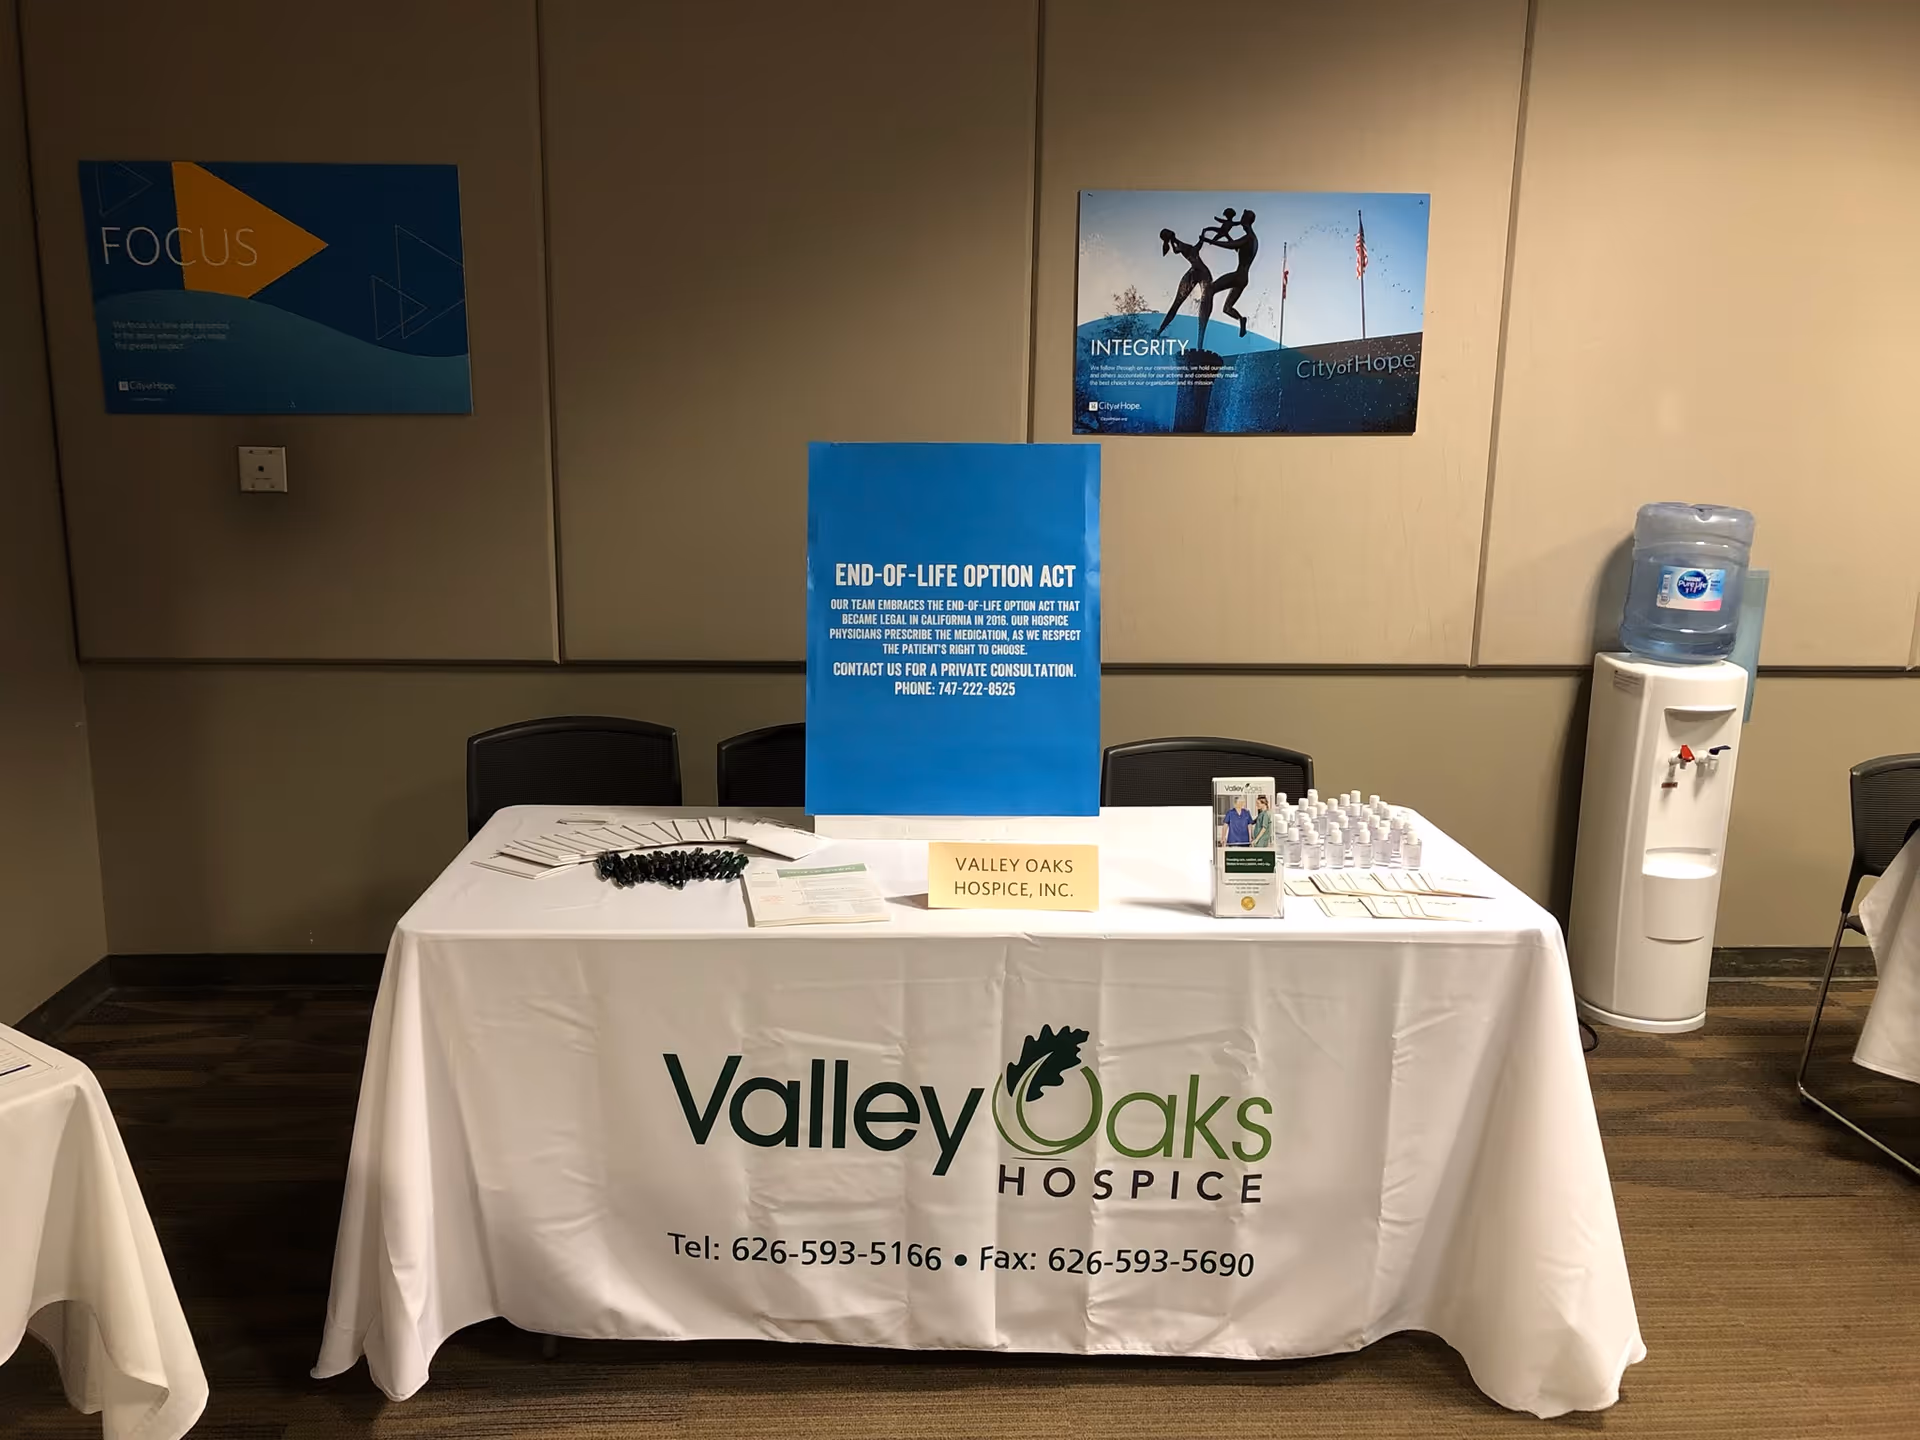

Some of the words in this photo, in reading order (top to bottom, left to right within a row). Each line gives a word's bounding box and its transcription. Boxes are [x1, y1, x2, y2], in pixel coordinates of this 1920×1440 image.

[100, 226, 258, 267] FOCUS
[1090, 338, 1190, 357] INTEGRITY
[1089, 371, 1099, 380] and
[1100, 371, 1116, 380] others
[1117, 371, 1147, 380] accountable
[1147, 371, 1156, 380] for
[1156, 371, 1165, 380] our
[1165, 371, 1183, 380] actions
[1184, 371, 1194, 380] and
[1195, 371, 1224, 380] consistently
[1224, 371, 1239, 380] make
[1090, 364, 1099, 373] We
[1100, 364, 1115, 373] follow
[1136, 364, 1143, 373] on
[1144, 364, 1153, 373] our
[1190, 364, 1198, 373] we
[1198, 364, 1210, 373] hold
[1089, 379, 1098, 388] the
[1099, 379, 1110, 388] best
[1110, 379, 1127, 388] choice
[1127, 379, 1136, 388] for
[1135, 379, 1145, 388] our
[1145, 379, 1176, 388] organization
[1176, 379, 1187, 388] and
[835, 563, 958, 587] END-OF-LIFE
[963, 564, 1033, 588] OPTION
[1039, 564, 1077, 588] ACT
[1678, 579, 1695, 588] Pure
[830, 598, 849, 610] OUR
[851, 599, 876, 610] TEAM
[878, 599, 925, 611] EMBRACES
[927, 599, 944, 611] THE
[946, 599, 1002, 611] END-OF-LIFE
[1004, 600, 1036, 612] OPTION
[1038, 600, 1055, 612] ACT
[1057, 600, 1080, 612] THAT
[842, 613, 877, 625] BECAME
[880, 614, 907, 625] LEGAL
[909, 614, 919, 625] IN
[921, 614, 972, 626] CALIFORNIA
[974, 615, 984, 625] IN
[986, 615, 1010, 626] 2016.
[1011, 615, 1029, 626] OUR
[1031, 614, 1069, 626] HOSPICE
[829, 628, 882, 640] PHYSICIANS
[884, 628, 933, 640] PRESCRIBE
[934, 629, 952, 640] THE
[954, 629, 1010, 641] MEDICATION,
[1012, 629, 1024, 641] AS
[1026, 629, 1040, 641] WE
[1042, 629, 1081, 641] RESPECT
[882, 643, 899, 654] THE
[902, 643, 947, 655] PATIENT'S
[949, 644, 975, 655] RIGHT
[978, 644, 989, 655] TO
[991, 644, 1028, 655] CHOOSE.
[833, 662, 884, 676] CONTACT
[887, 662, 902, 677] US
[905, 662, 927, 677] FOR
[930, 663, 937, 677] A
[941, 663, 987, 677] PRIVATE
[990, 663, 1077, 678] CONSULTATION.
[894, 681, 935, 695] PHONE:
[938, 681, 1016, 696] 747-222-8525
[1224, 784, 1244, 793] Valley
[955, 857, 1020, 872] VALLEY
[1025, 858, 1073, 874] OAKS
[954, 880, 1033, 899] HOSPICE,
[1039, 882, 1074, 898] INC.
[662, 1053, 985, 1176] Valley
[992, 1060, 1274, 1164] Oaks
[996, 1163, 1264, 1204] HOSPICE
[667, 1232, 722, 1263] Tel:
[731, 1236, 943, 1271] 626-593-5166
[979, 1245, 1037, 1273] Fax:
[1047, 1247, 1256, 1278] 626-593-5690
